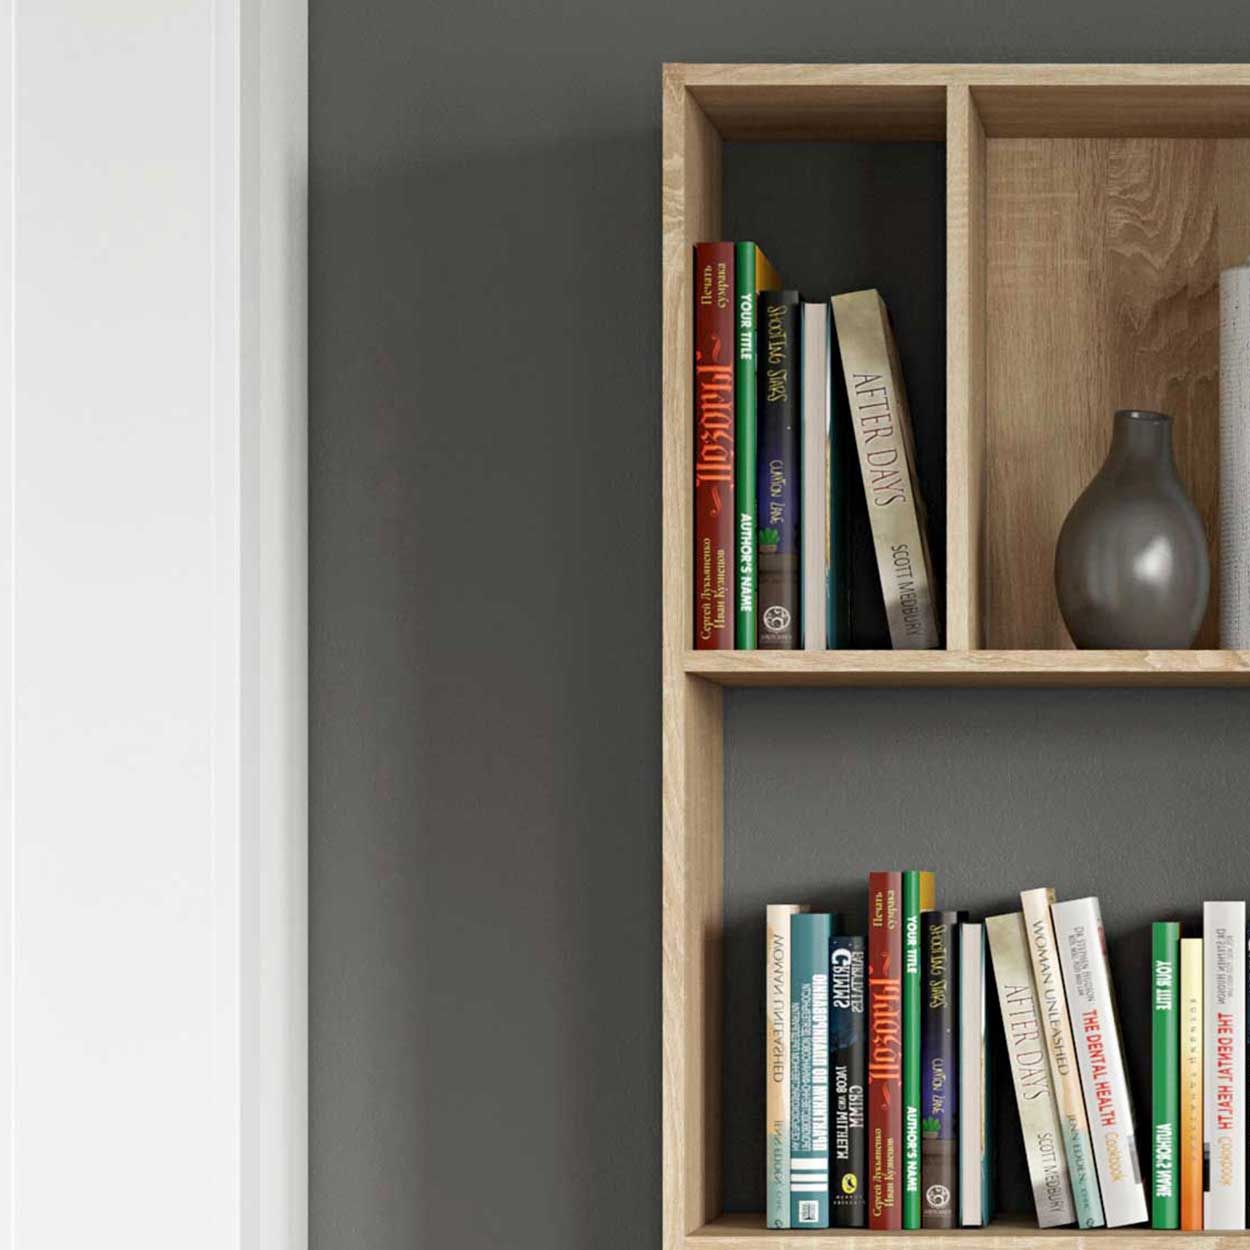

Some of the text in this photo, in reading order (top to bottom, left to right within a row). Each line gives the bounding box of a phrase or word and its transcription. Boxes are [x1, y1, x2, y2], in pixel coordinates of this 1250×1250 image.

[701, 265, 713, 305] Печать
[740, 293, 752, 360] YOUR TITLE
[852, 373, 906, 508] AFTER DAYS
[740, 513, 752, 612] AUTHOR'S NAME
[891, 544, 920, 637] SCOTT MEDBURY
[907, 916, 918, 974] YOUR TITLE
[1004, 984, 1050, 1102] AFTER DAYS
[1033, 920, 1068, 1076] WOMAN UNLEASHED
[1081, 1009, 1126, 1183] THE DENTAL HEALTH Cookbook
[907, 1106, 918, 1192] AUTHOR'S NAME
[1037, 1133, 1056, 1163] SCOTT
